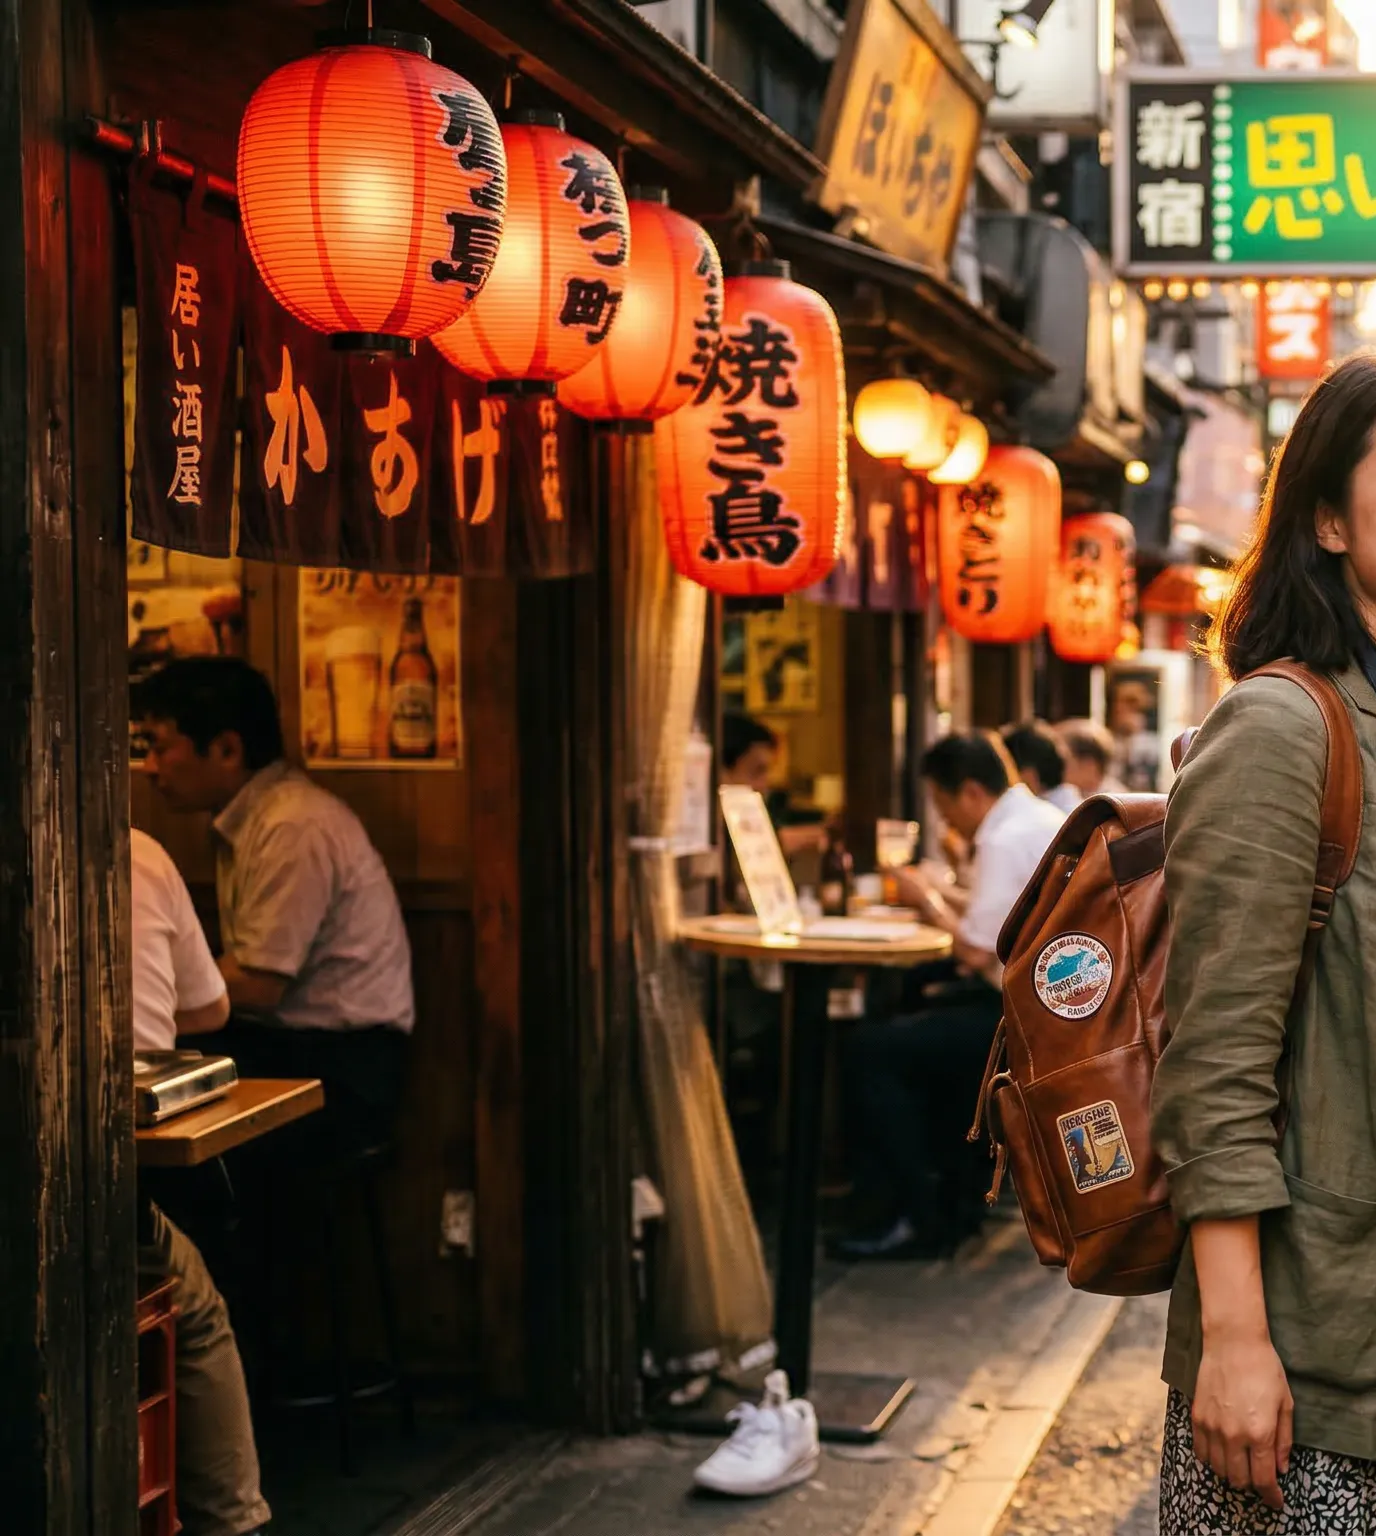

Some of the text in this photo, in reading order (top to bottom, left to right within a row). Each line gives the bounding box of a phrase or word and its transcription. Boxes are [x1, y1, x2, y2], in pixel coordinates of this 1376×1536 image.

[1136, 101, 1204, 248] 新宿
[167, 263, 203, 507] 居い酒屋
[690, 317, 801, 567] 焼き鳥
